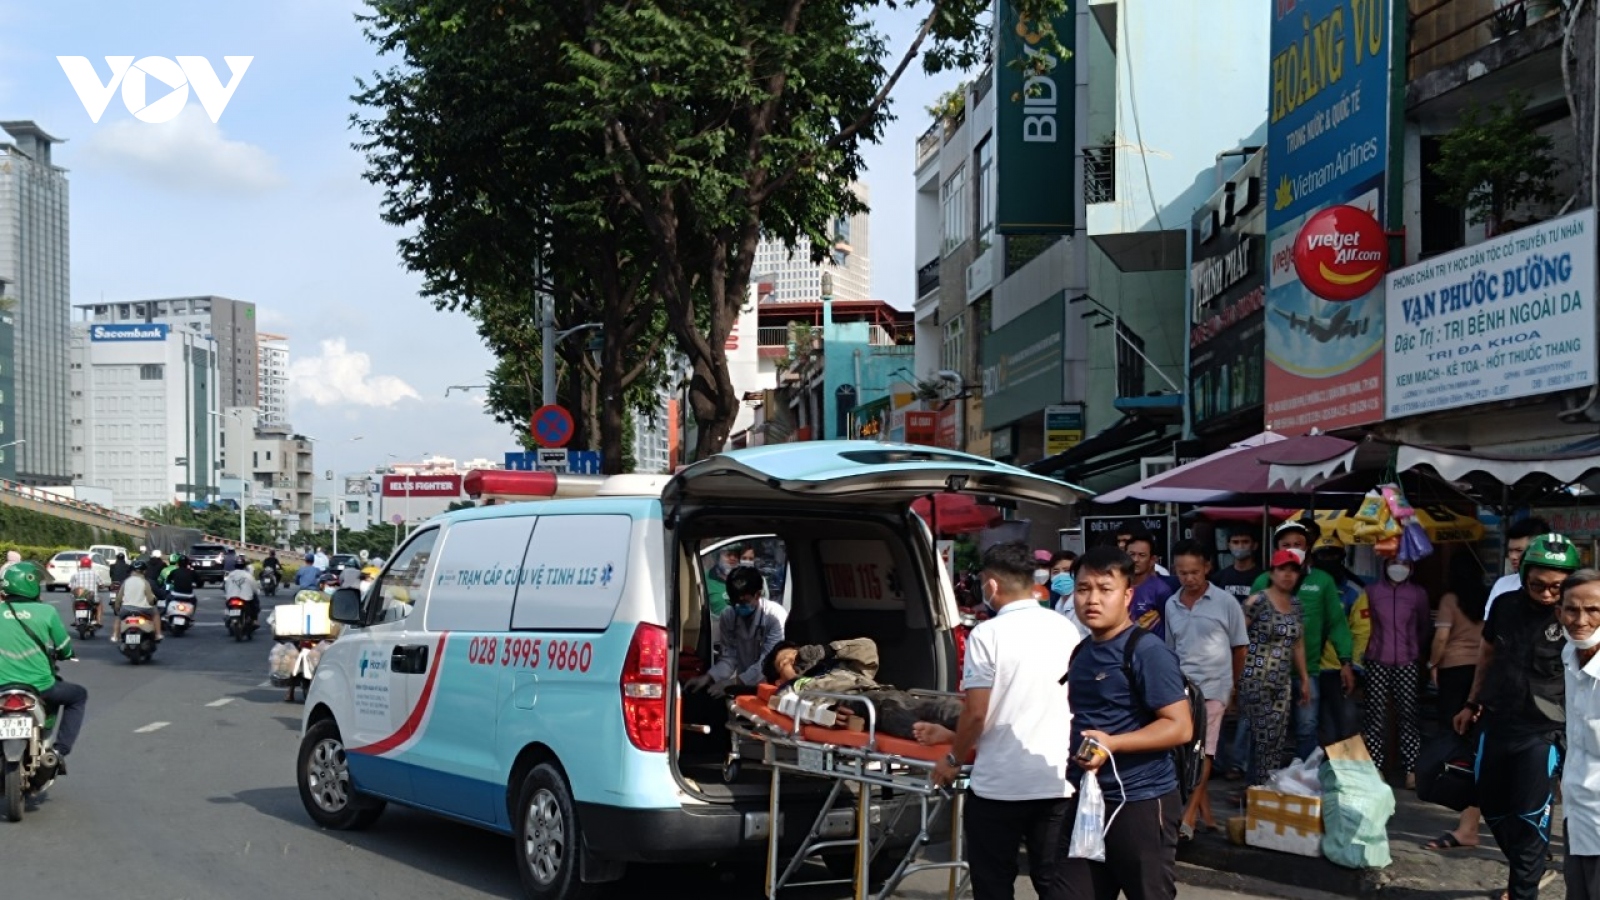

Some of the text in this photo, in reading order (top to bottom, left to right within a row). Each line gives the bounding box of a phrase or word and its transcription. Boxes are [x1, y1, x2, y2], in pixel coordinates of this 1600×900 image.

[1271, 6, 1345, 124] HOÀNG
[1292, 136, 1378, 201] Vietnam Airlines
[1401, 252, 1573, 327] VẠN PHƯỚC ĐƯỜNG
[94, 326, 161, 339] Sacombank
[1394, 335, 1415, 355] Đặc
[1509, 293, 1556, 328] NGOÀI
[1560, 289, 1582, 313] DA
[1488, 329, 1541, 350] KHOA
[1544, 338, 1582, 356] THANG
[389, 481, 453, 491] IELTS FIGHTER
[1545, 552, 1567, 562] Grab
[456, 569, 482, 590] TRẠM
[546, 567, 576, 585] TINH
[576, 567, 598, 585] 115
[468, 636, 593, 674] 028 3995 9860
